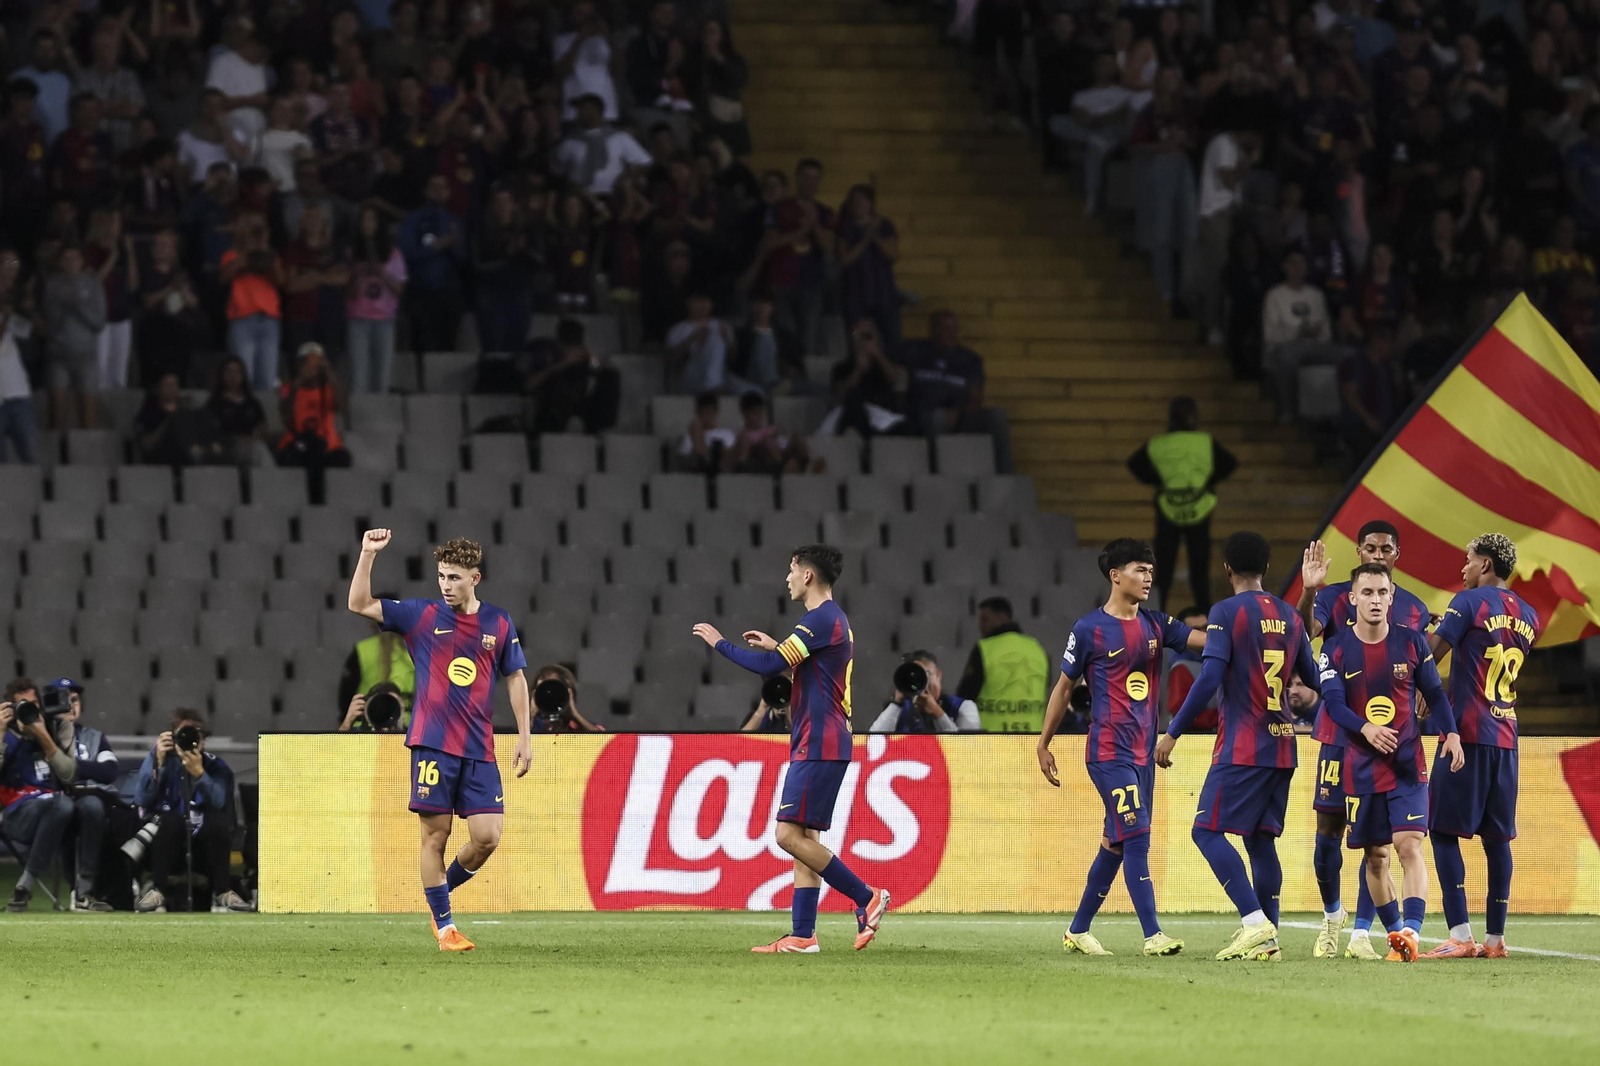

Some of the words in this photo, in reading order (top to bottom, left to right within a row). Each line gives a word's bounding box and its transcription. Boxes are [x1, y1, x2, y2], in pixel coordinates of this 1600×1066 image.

[1260, 619, 1287, 635] BALDE
[1263, 649, 1285, 711] 3
[1484, 643, 1524, 703] 10
[417, 760, 440, 785] 16
[1320, 759, 1340, 786] 14
[1111, 784, 1141, 814] 27
